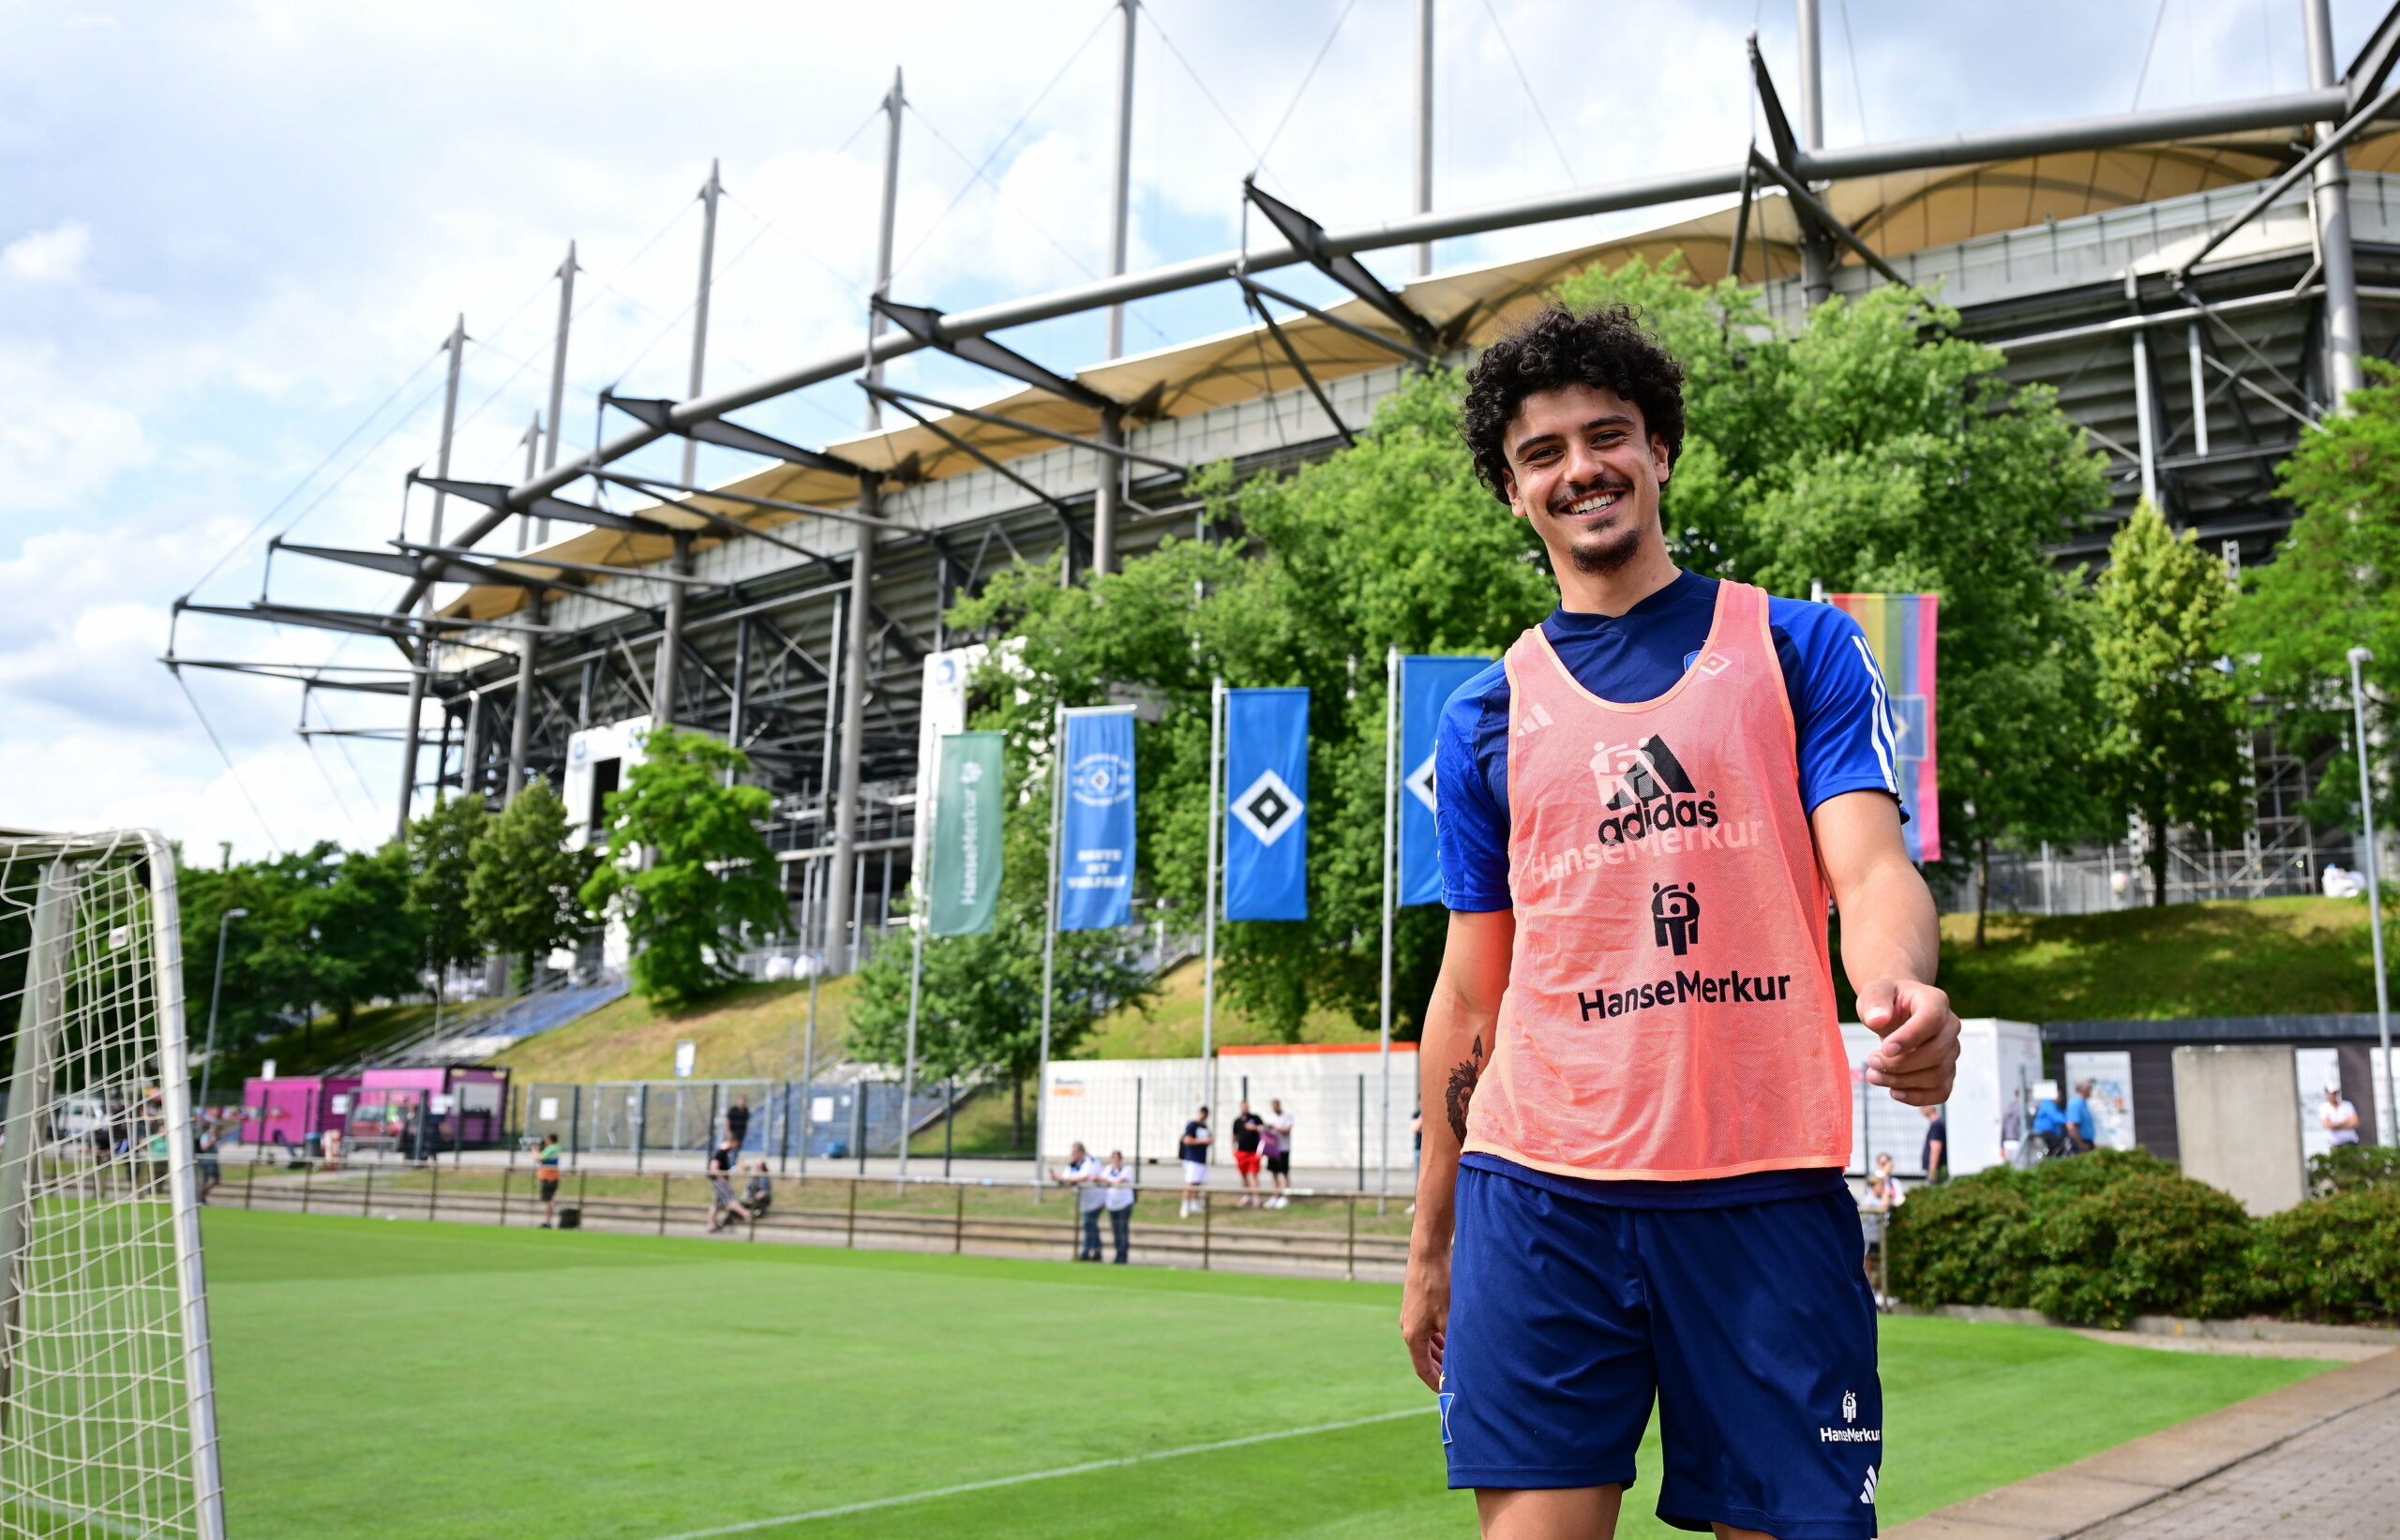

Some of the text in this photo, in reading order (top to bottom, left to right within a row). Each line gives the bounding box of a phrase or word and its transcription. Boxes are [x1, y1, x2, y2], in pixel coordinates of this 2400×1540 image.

[1598, 793, 1718, 845] adidas
[1531, 818, 1764, 884] HanseMerkur
[1578, 970, 1791, 1022] HanseMerkur
